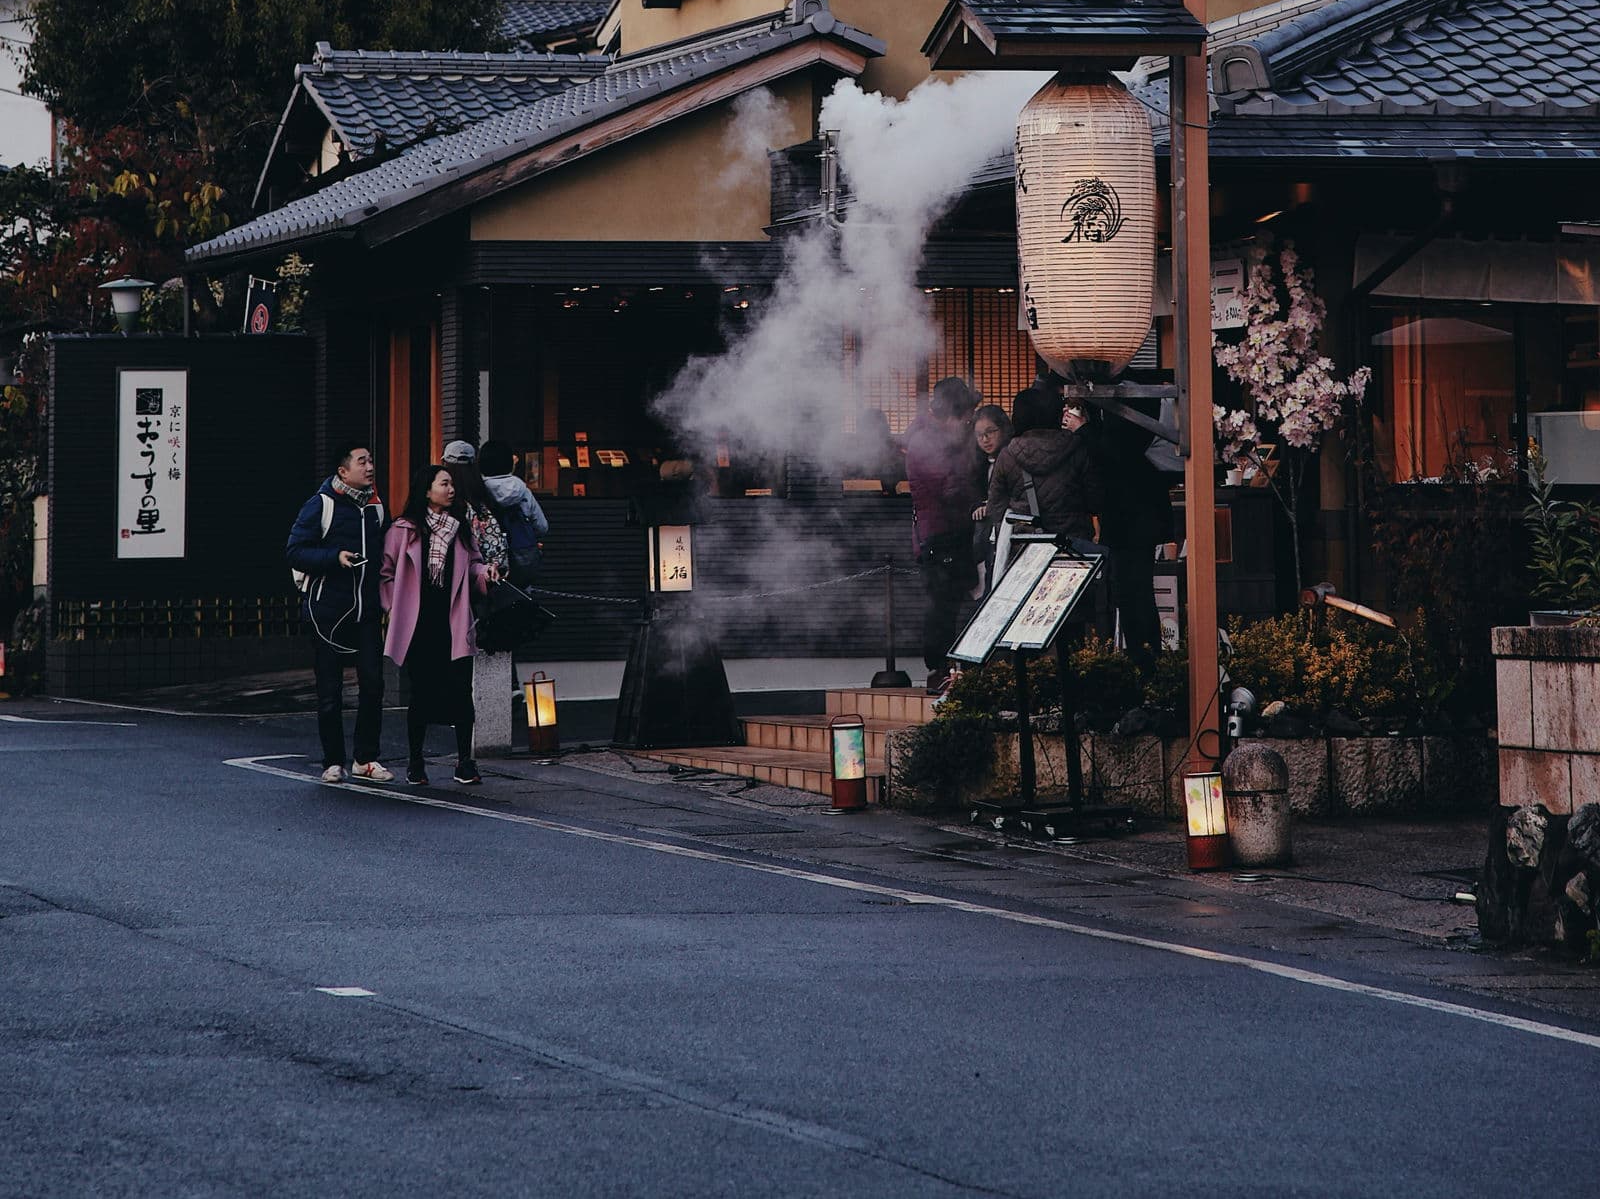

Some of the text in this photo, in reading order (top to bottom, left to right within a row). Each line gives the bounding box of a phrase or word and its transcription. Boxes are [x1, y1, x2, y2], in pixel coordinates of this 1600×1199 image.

[130, 416, 166, 536] おうすの里
[167, 404, 182, 481] 京に咲く梅
